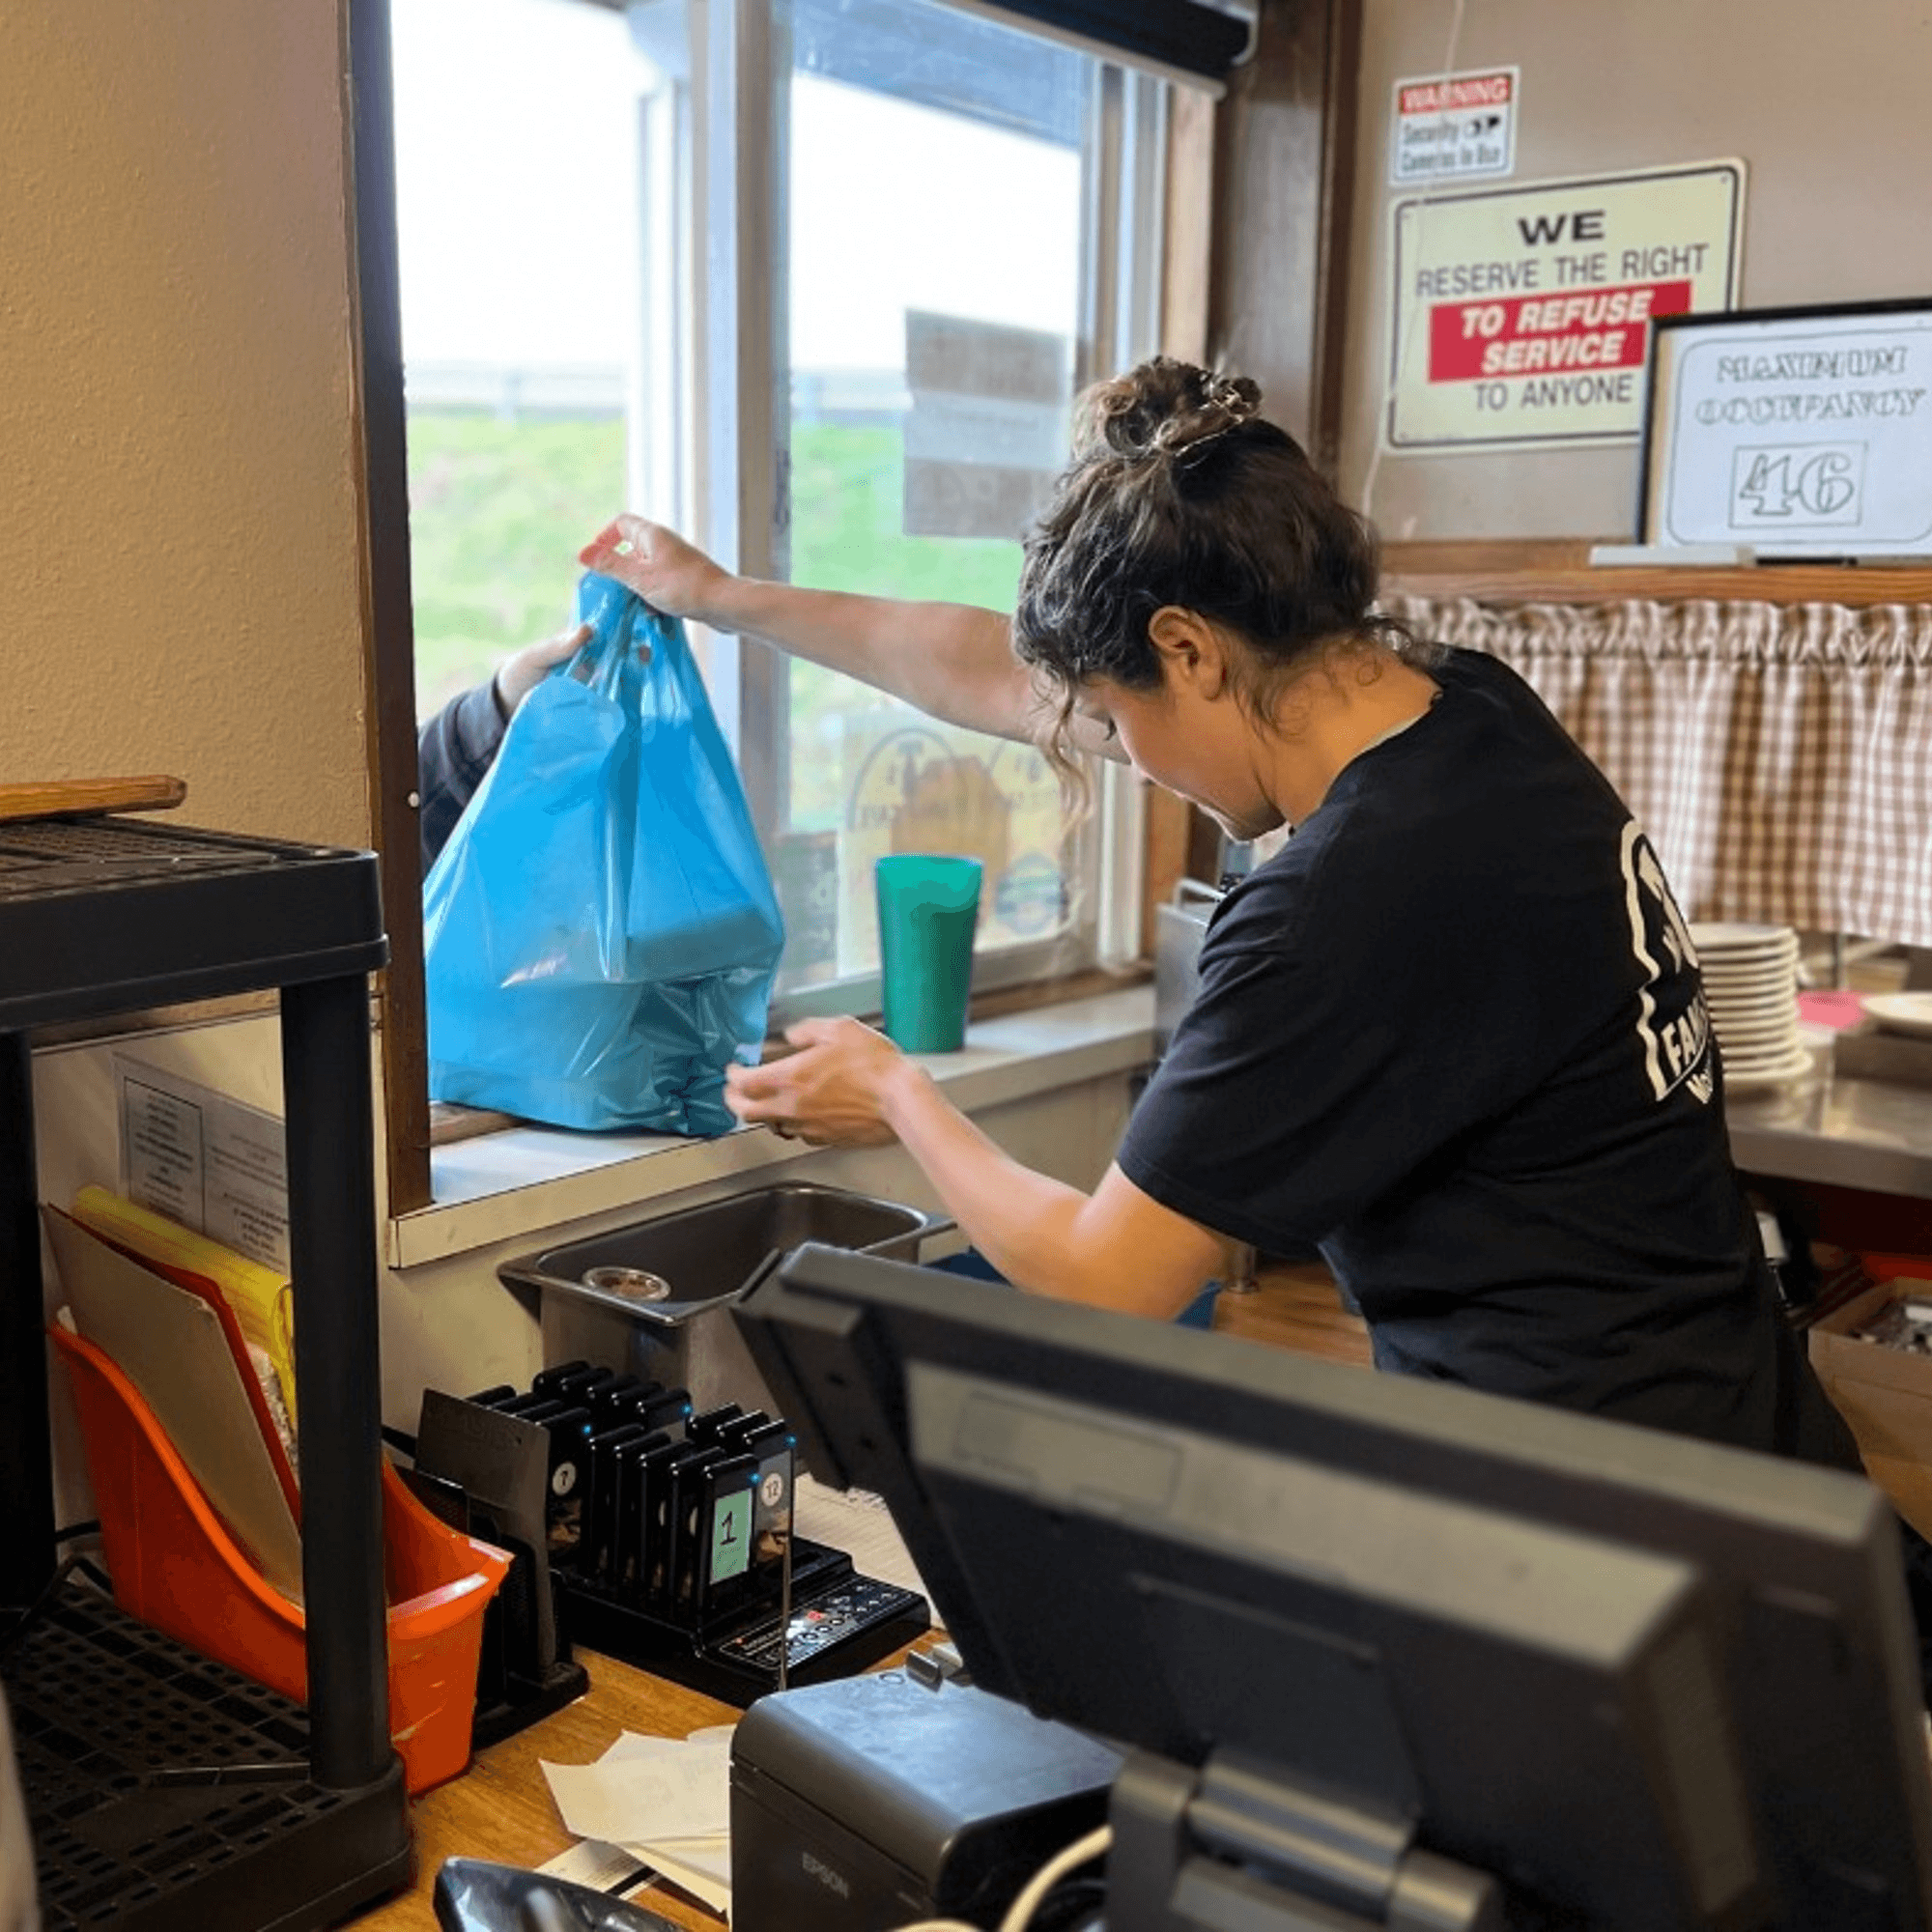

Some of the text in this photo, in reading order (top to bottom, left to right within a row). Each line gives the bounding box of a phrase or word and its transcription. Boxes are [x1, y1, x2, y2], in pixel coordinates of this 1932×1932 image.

[1405, 77, 1509, 109] WARNING
[1404, 123, 1460, 145] Security
[1518, 210, 1606, 246] WE
[1416, 242, 1710, 297] RESERVE THE RIGHT
[1461, 290, 1653, 339] TO REFUSE
[1482, 331, 1626, 373] SERVICE
[1717, 345, 1909, 384] MAXIMUM
[1474, 374, 1634, 412] TO ANYONE
[1694, 387, 1927, 426] OCCUPANCY
[1739, 451, 1856, 517] 46
[719, 1510, 738, 1546] 1
[801, 1850, 849, 1900] EPSON
